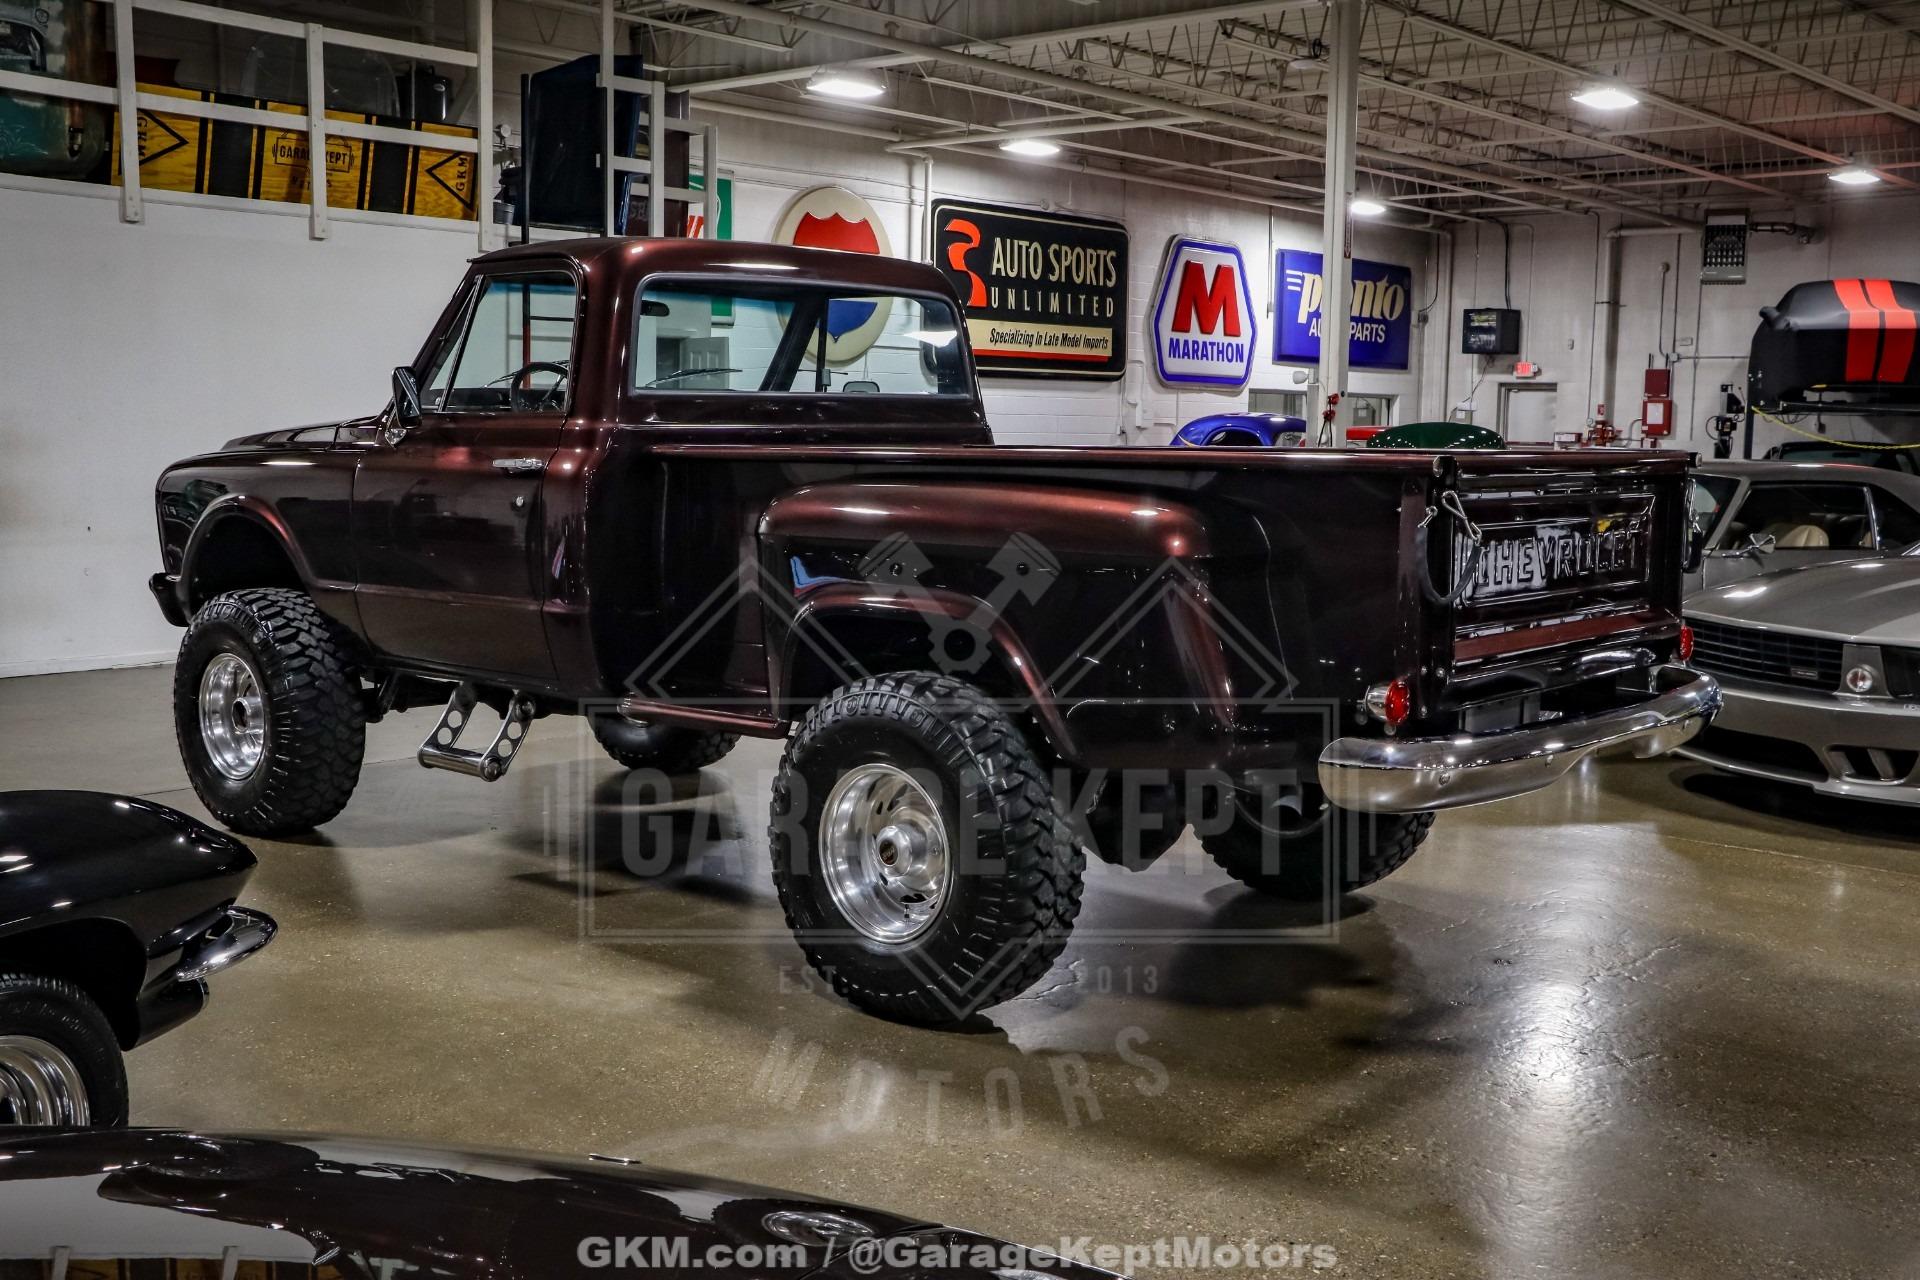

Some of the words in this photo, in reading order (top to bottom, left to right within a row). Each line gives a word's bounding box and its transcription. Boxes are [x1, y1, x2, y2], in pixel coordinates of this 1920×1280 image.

[455, 157, 468, 191] GKM
[991, 237, 1043, 281] AUTO
[1048, 243, 1117, 288] SPORTS
[990, 286, 1114, 318] UNLIMITED
[1171, 260, 1241, 337] M
[990, 328, 1034, 348] Specializing
[1035, 332, 1043, 344] In
[1044, 332, 1059, 346] Late
[1060, 333, 1081, 348] Model
[1083, 334, 1109, 350] Imports
[1350, 322, 1386, 344] PARTS
[1168, 337, 1244, 363] MARATHON
